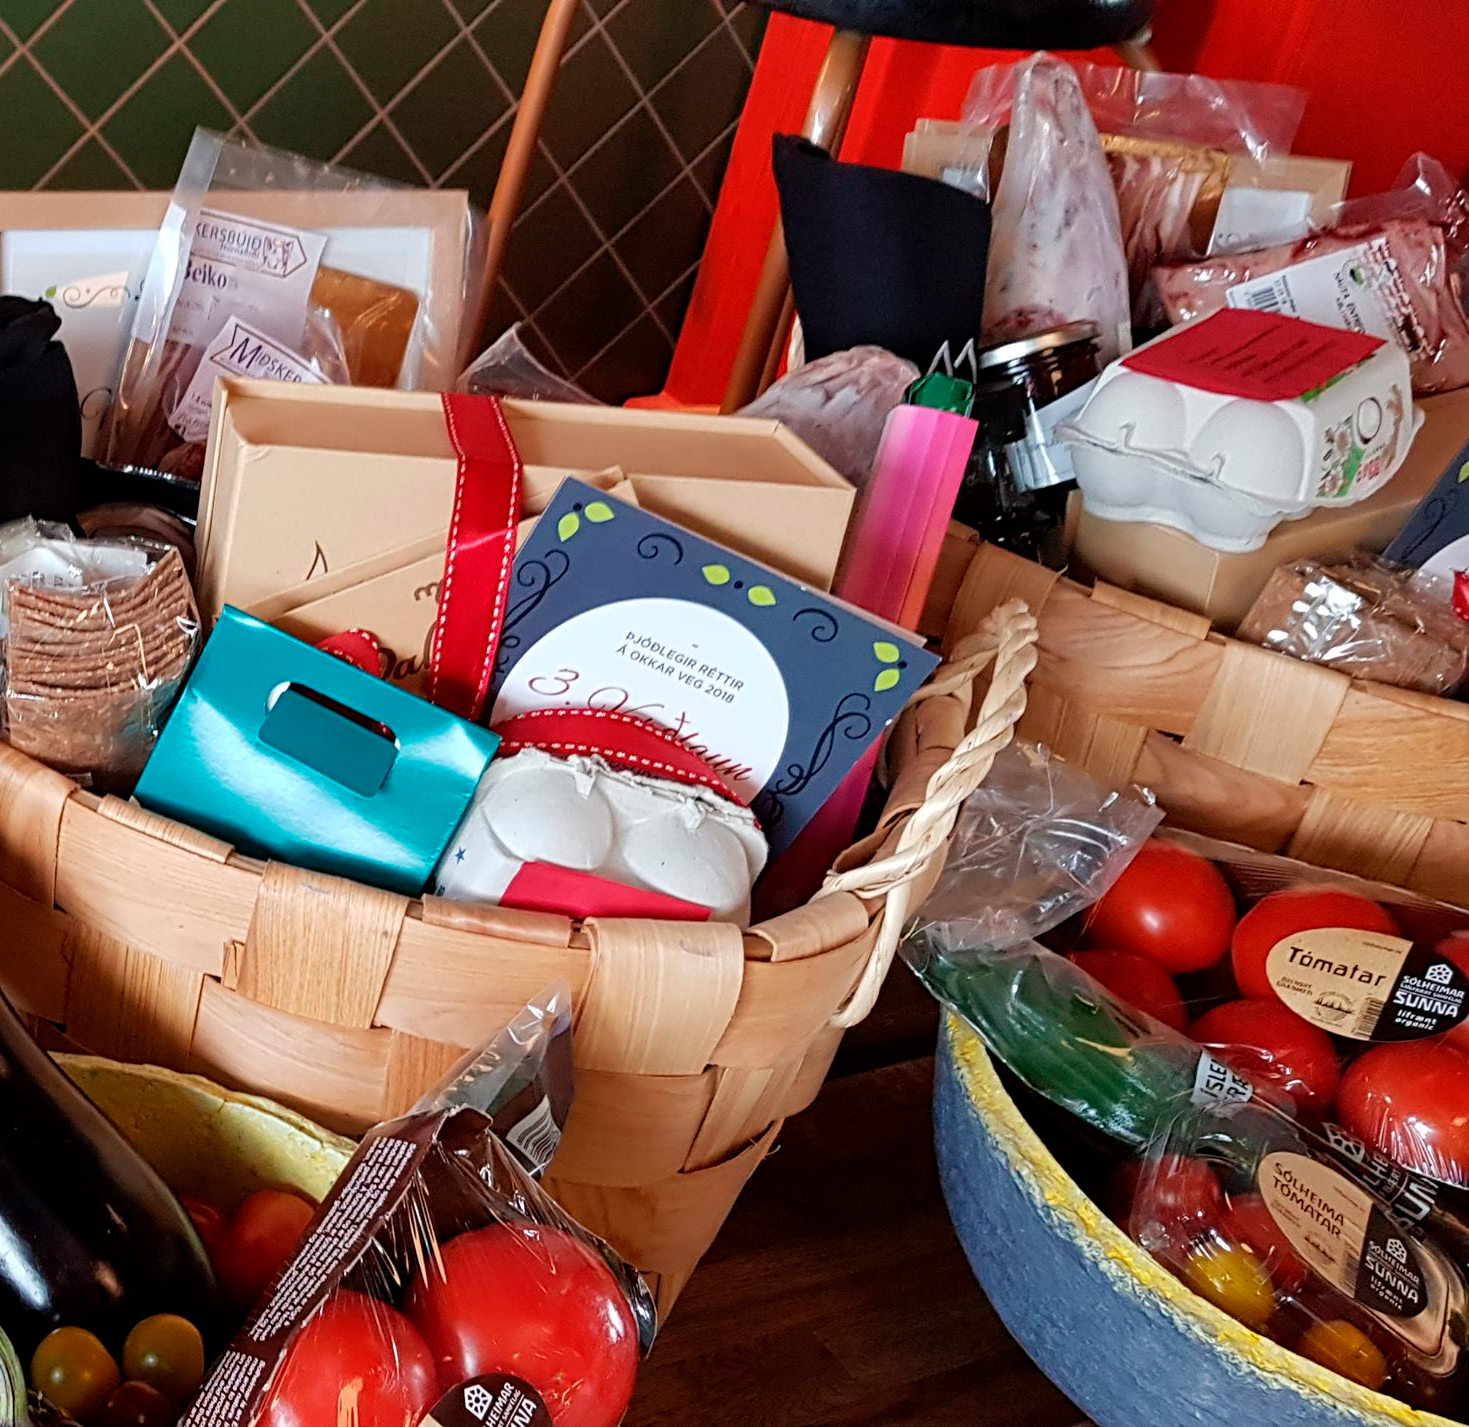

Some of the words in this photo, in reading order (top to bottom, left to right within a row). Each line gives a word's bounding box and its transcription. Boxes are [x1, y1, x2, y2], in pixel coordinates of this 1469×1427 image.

[615, 642, 627, 657] Á
[629, 649, 676, 678] OKKAR
[677, 670, 704, 691] VEG
[704, 683, 737, 705] 2018
[625, 631, 696, 671] ÞJÓÐLEGIR
[698, 662, 745, 692] RÉTTIR
[1288, 945, 1387, 988] Tómatar
[1402, 973, 1466, 999] SÓLHEIMAR
[1392, 990, 1460, 1018] SUNNA
[1271, 1174, 1343, 1241] TÓMATAR
[1273, 1161, 1345, 1227] SÓLHEIMA
[1364, 1255, 1419, 1304] SUNNA
